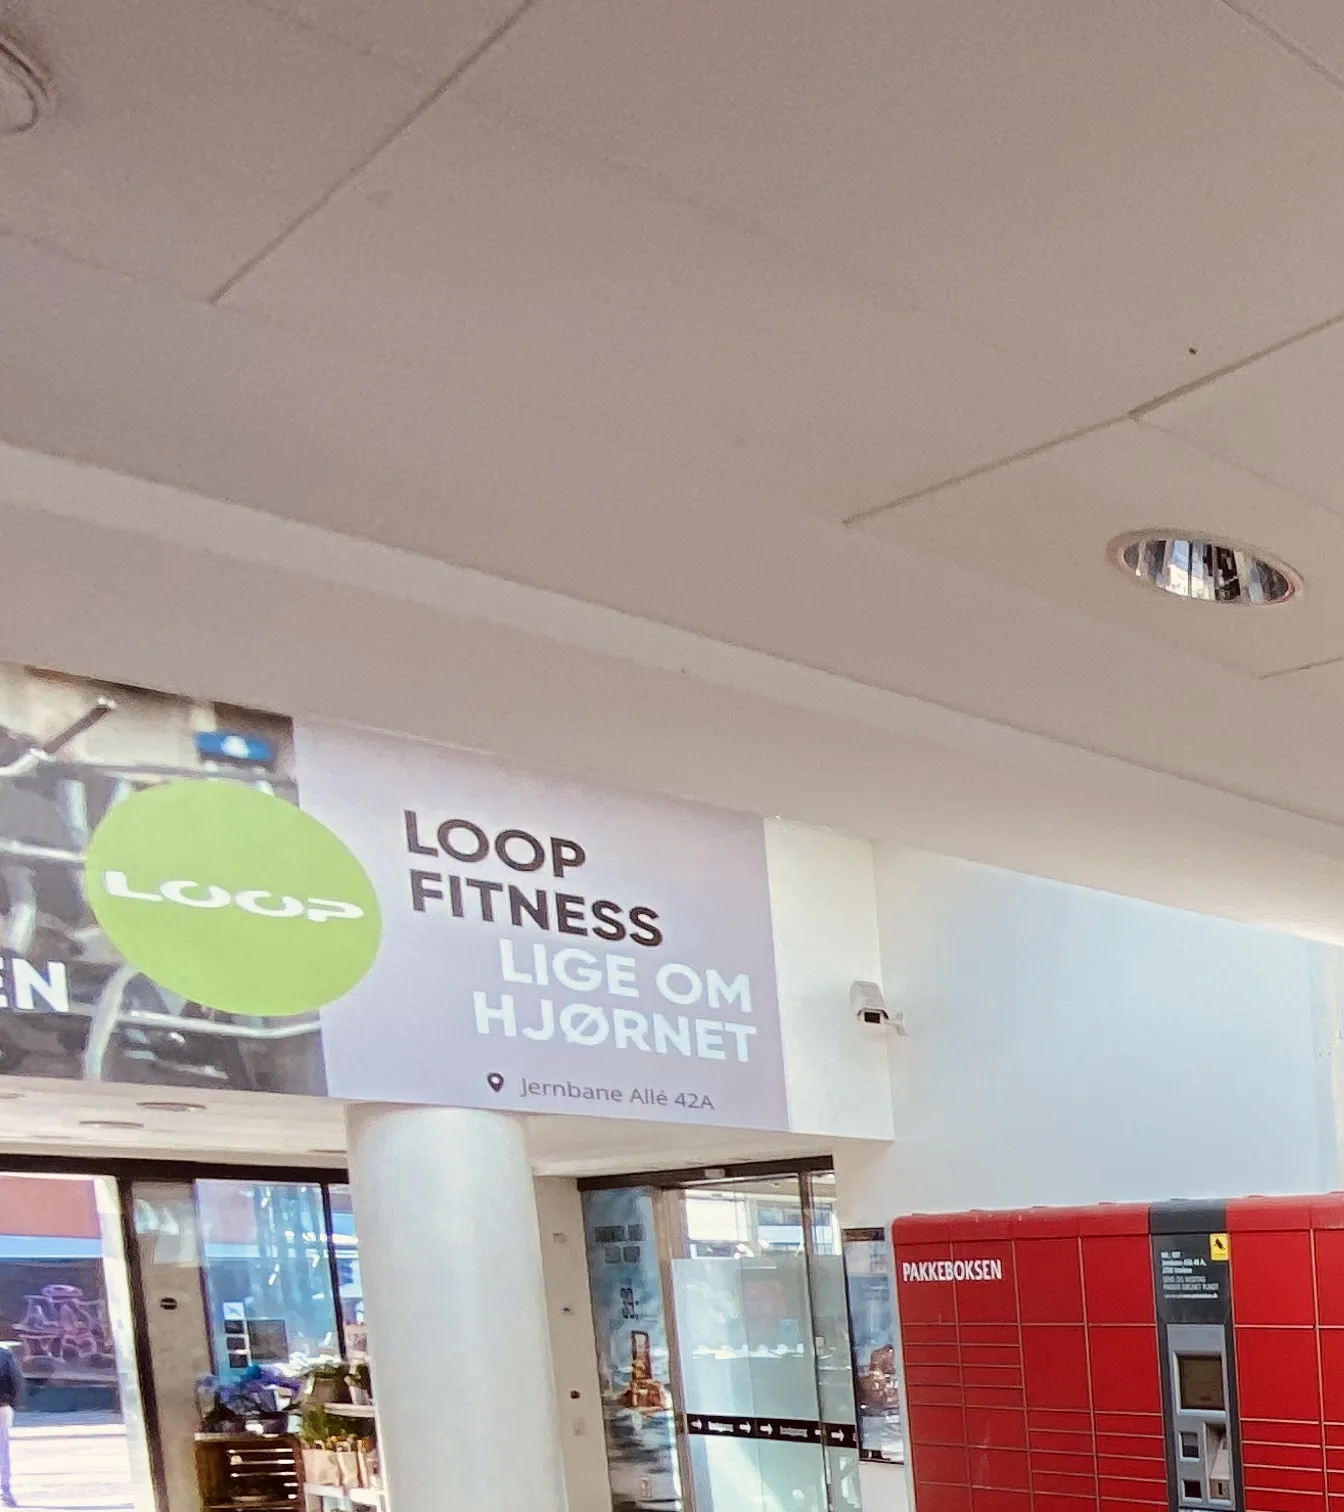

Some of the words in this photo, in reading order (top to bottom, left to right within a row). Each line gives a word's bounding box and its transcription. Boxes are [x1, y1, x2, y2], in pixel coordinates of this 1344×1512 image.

[404, 809, 586, 879] LOOP
[104, 868, 365, 922] LOOP
[409, 868, 664, 947] FITNESS
[499, 938, 640, 998] LIGE
[655, 963, 752, 1014] OM
[472, 990, 757, 1063] HJØRNET
[520, 1077, 623, 1103] Jernbane
[629, 1087, 668, 1107] Allé
[674, 1091, 716, 1111] 42A
[902, 1259, 1003, 1281] PAKKEBOKSEN
